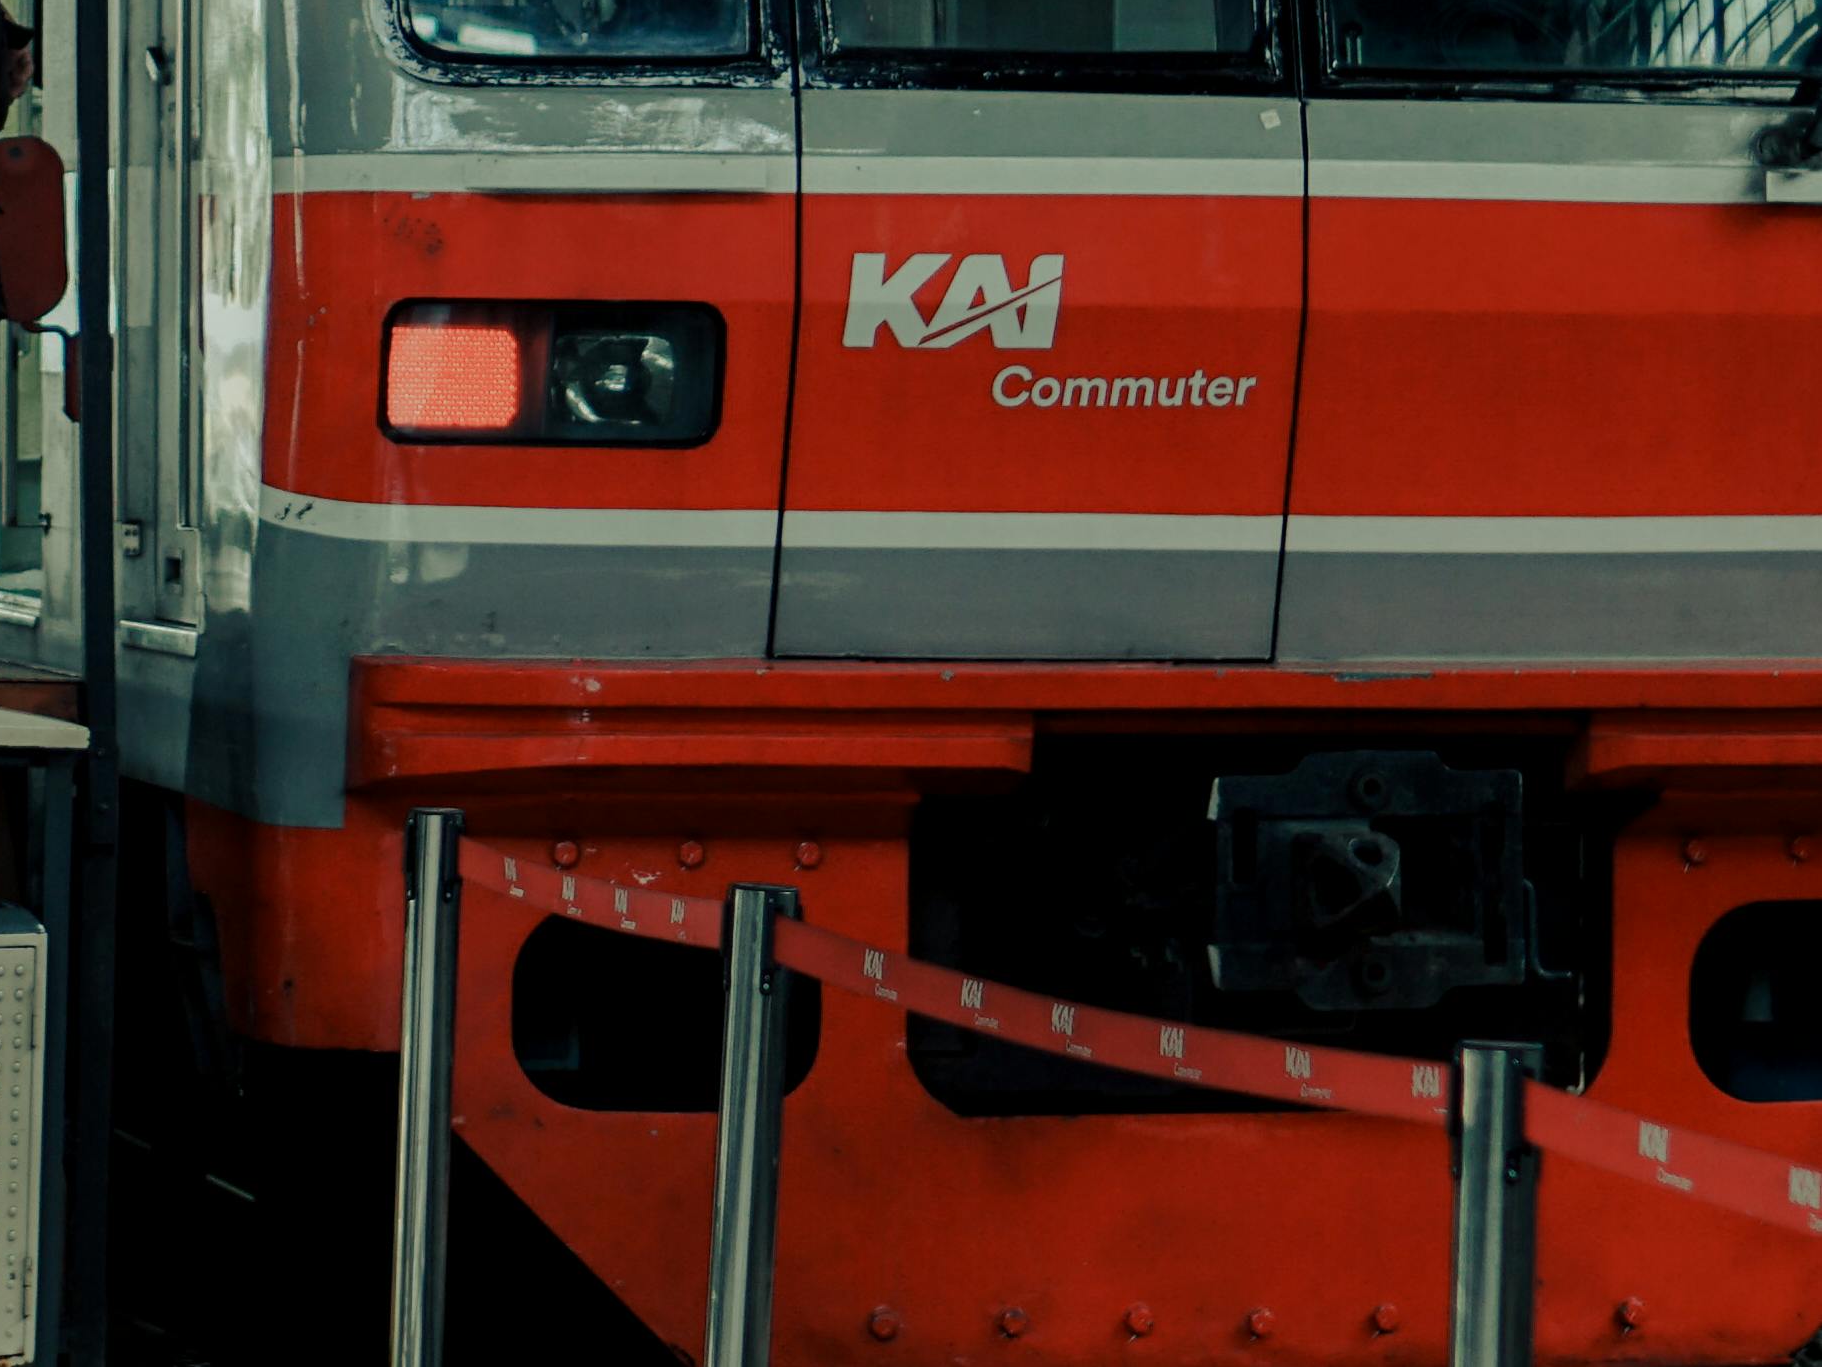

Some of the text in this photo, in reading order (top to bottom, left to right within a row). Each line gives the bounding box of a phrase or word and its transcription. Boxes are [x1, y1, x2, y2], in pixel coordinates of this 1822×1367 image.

[842, 252, 1065, 349] KAI
[991, 364, 1257, 408] Commuter
[863, 948, 884, 980] KAI
[961, 978, 983, 1009] KAI
[1051, 1003, 1075, 1035] KAI
[1160, 1025, 1185, 1058] KAI
[1285, 1046, 1311, 1079] KAI
